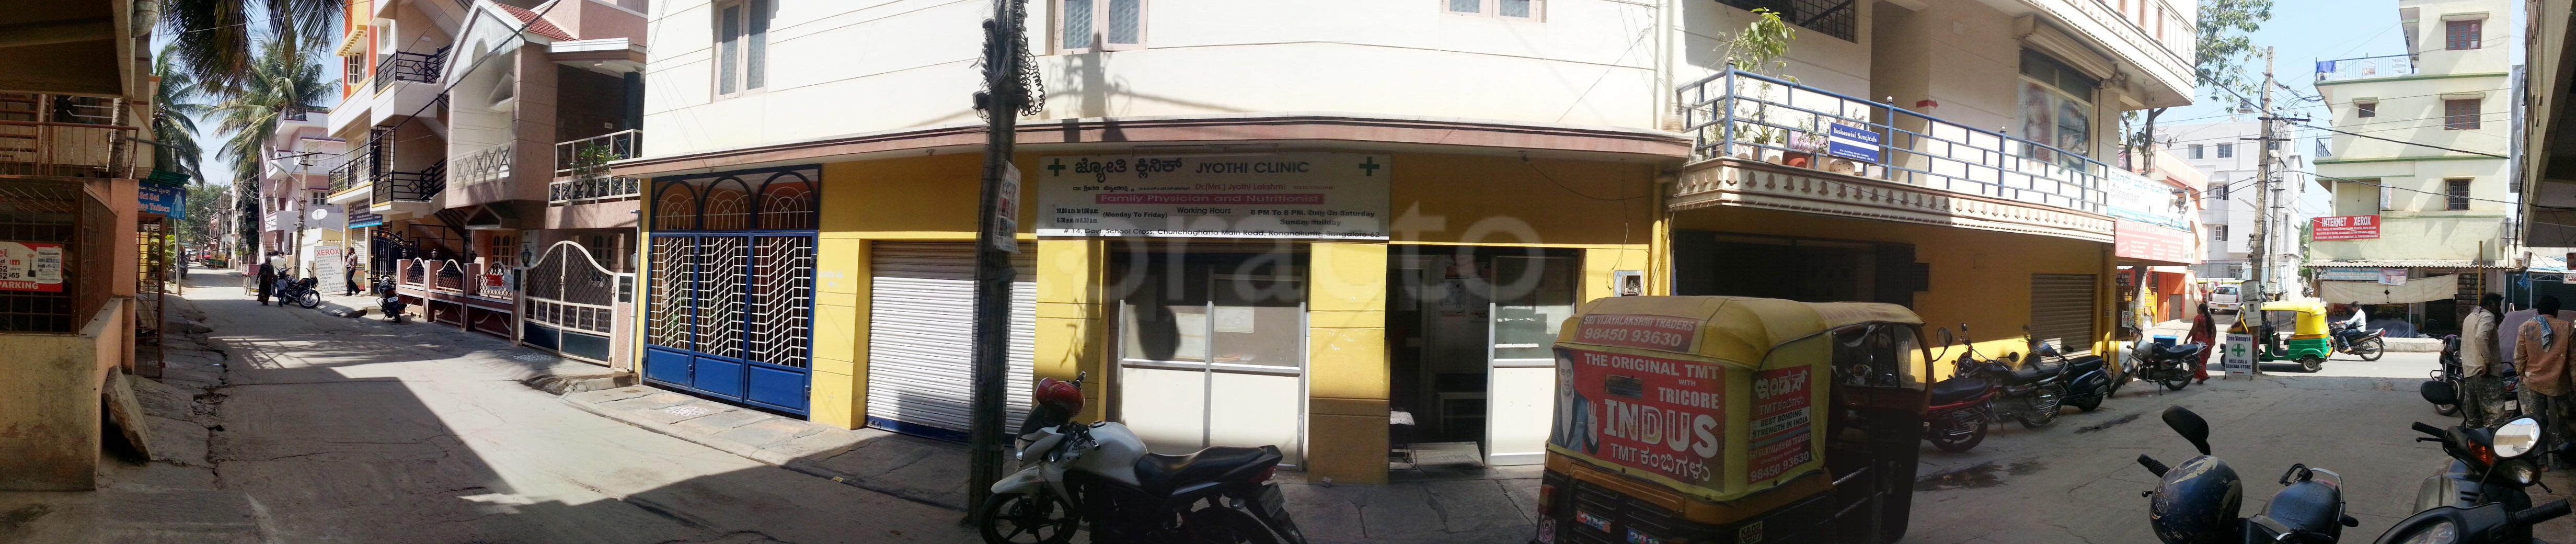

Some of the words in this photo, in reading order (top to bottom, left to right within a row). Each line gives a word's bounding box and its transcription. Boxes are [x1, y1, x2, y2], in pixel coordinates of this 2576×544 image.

[1833, 127, 1856, 138] Yashaswini
[1857, 133, 1877, 142] Surgicals
[1075, 157, 1127, 183] ಜ್ಯೋತಿ
[1135, 157, 1182, 178] ಕ್ಲಿನಿಕ್
[1195, 162, 1248, 173] JYOTHI
[1254, 162, 1310, 173] CLINIC
[1228, 183, 1251, 191] Jyothi
[1101, 195, 1144, 203] Family
[1148, 195, 1209, 203] Physician
[1246, 194, 1319, 202] Nutritionist
[2322, 217, 2347, 226] INTERNET
[2354, 216, 2371, 225] XEROX
[1584, 316, 1595, 325] SRI
[1596, 316, 1654, 327] VIJAYALAKSHMI
[1655, 318, 1695, 331] TRADERS
[1584, 328, 1628, 341] 98450
[1631, 329, 1682, 347] 93630
[1584, 353, 1608, 367] THE
[1611, 356, 1680, 376] ORIGINAL
[1684, 364, 1721, 380] TMT
[1658, 387, 1720, 410] TRICORE
[1758, 402, 1777, 415] TMT
[1752, 423, 1785, 438] STRENGTH
[1793, 416, 1808, 426] INDIA
[1761, 416, 1776, 427] BEST
[1777, 409, 1802, 422] BONDING
[1604, 399, 1719, 459] INDUS
[1793, 432, 1810, 445] TRADERS
[1611, 443, 1638, 463] TMT
[1641, 446, 1711, 482] ಕಂಬಿಗಳು
[1751, 463, 1780, 481] 98450
[1782, 451, 1809, 470] 93630
